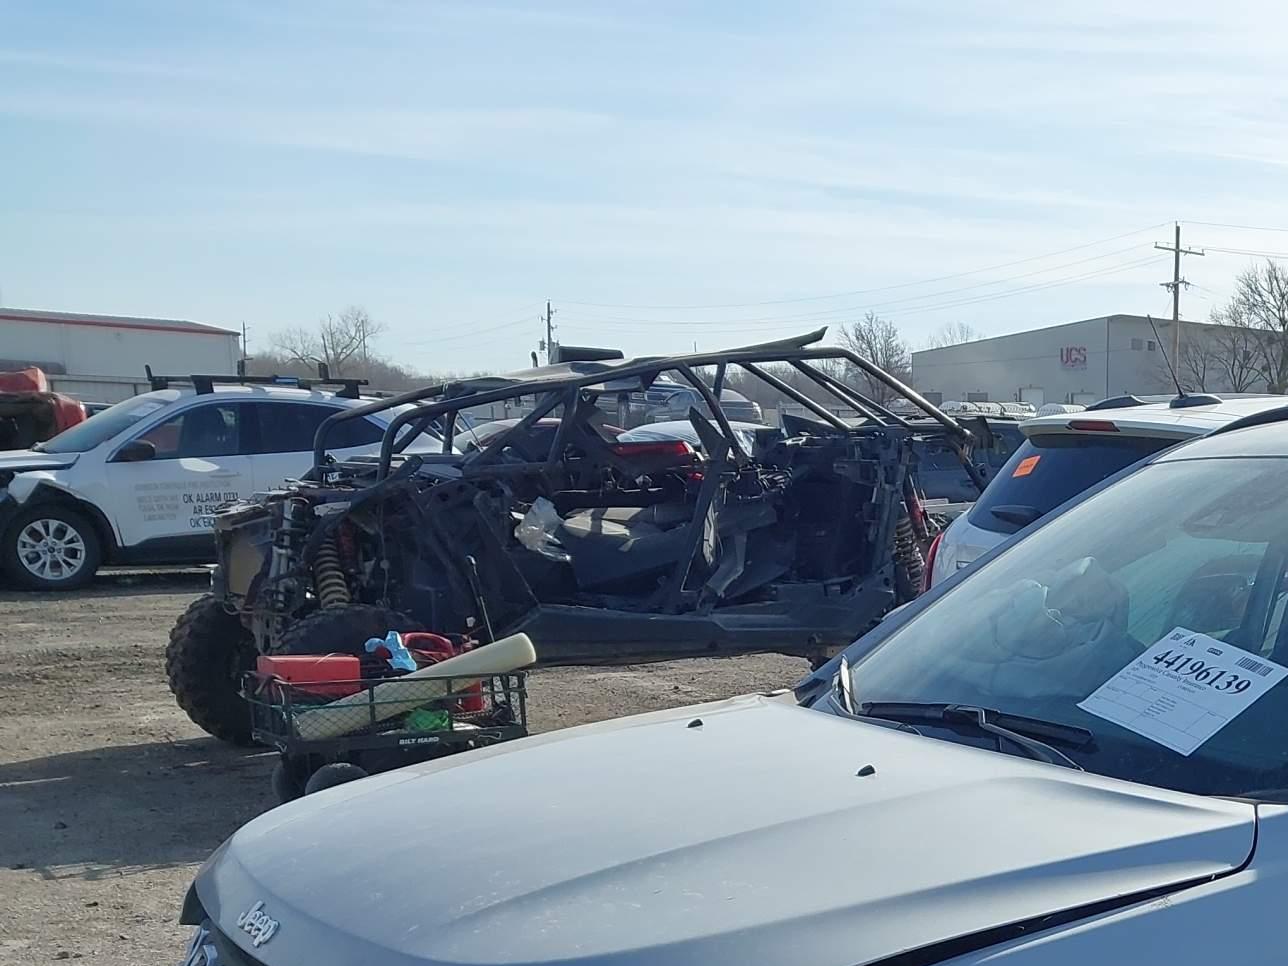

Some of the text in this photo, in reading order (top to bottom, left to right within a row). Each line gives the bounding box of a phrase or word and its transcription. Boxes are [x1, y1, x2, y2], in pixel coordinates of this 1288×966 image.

[1060, 347, 1087, 365] UCS
[183, 493, 194, 504] OK
[196, 491, 221, 503] ALARM
[1152, 649, 1251, 695] 44196139
[237, 900, 280, 948] Jeep
